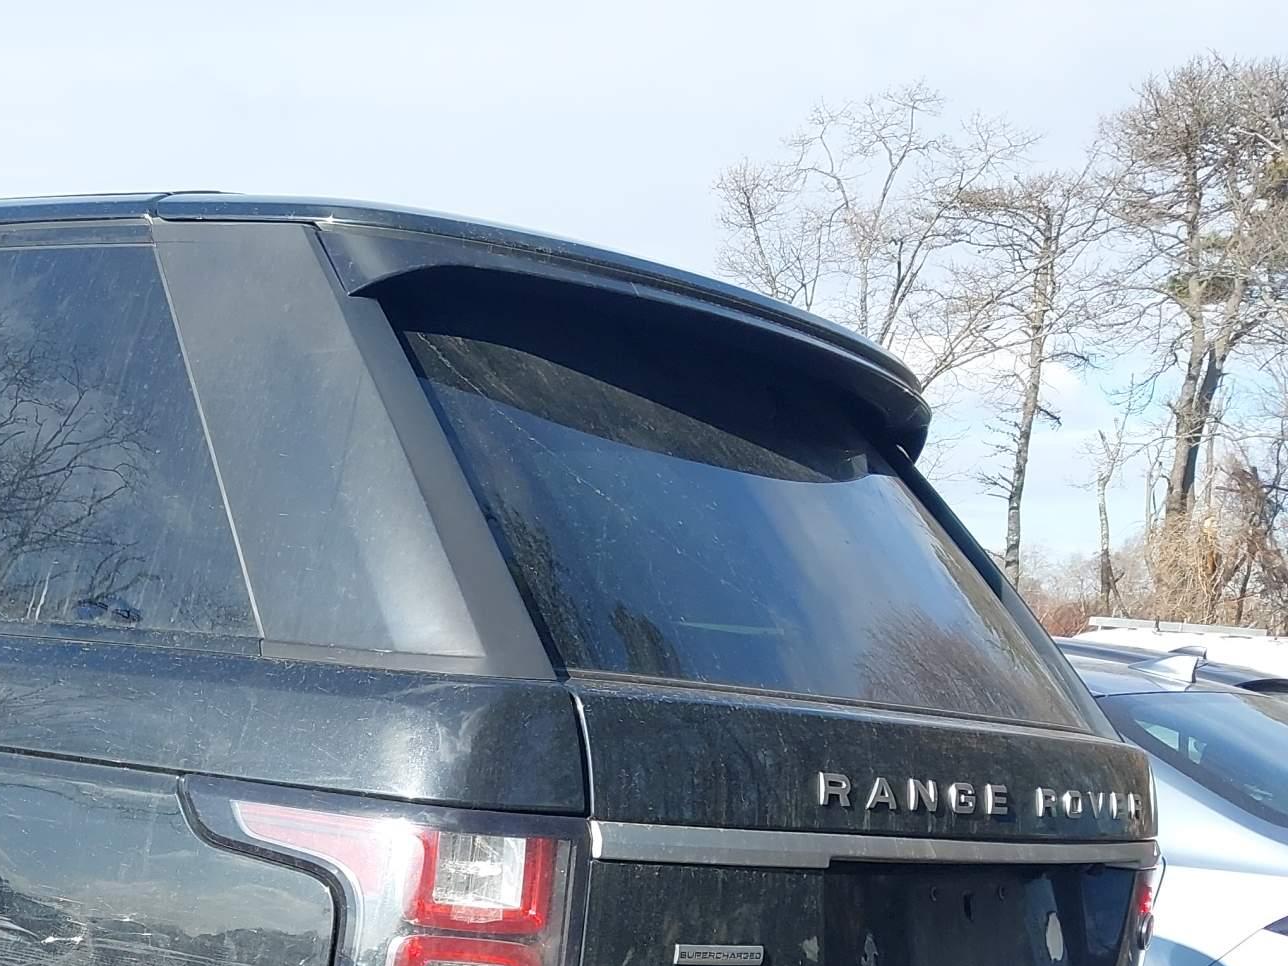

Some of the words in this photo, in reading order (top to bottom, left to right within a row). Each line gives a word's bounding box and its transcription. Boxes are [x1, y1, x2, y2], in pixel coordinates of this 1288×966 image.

[817, 770, 1009, 815] RANGE
[1035, 786, 1145, 821] ROVER
[679, 951, 762, 960] SUPERCHARGED
